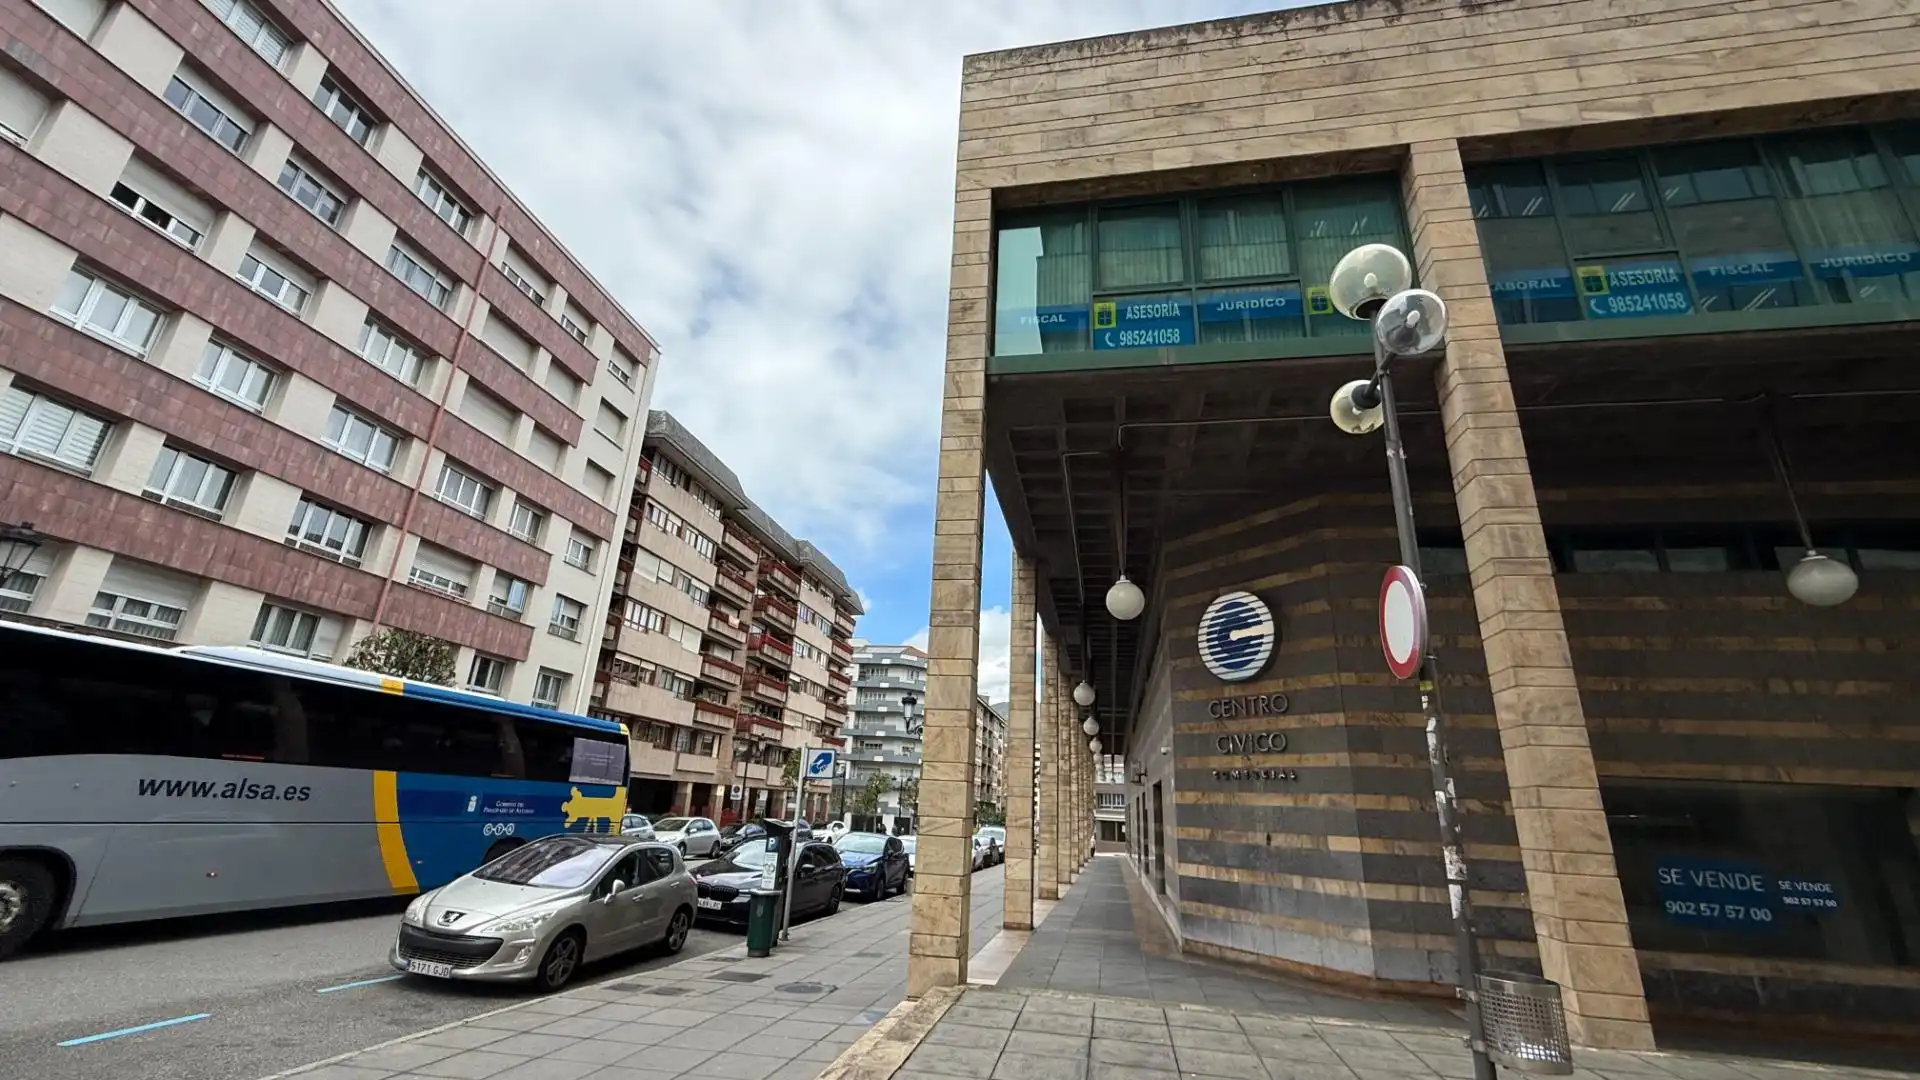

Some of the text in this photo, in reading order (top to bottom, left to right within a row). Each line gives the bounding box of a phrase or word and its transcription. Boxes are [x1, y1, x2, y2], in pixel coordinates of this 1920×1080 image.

[1608, 265, 1680, 287] ASESORÍA
[1708, 263, 1775, 277] FISCAL
[1493, 278, 1561, 292] ABORAL
[1125, 300, 1181, 320] ASESORÍA
[1607, 292, 1686, 313] 985241058
[1020, 314, 1067, 326] FISCAL
[1119, 328, 1181, 346] 985241058
[1208, 694, 1289, 718] CENTRO
[138, 777, 312, 802] www.alsa.es
[1658, 866, 1766, 892] SE VENDE
[1778, 880, 1834, 894] SE VENDE
[1665, 900, 1773, 922] 902 57 57 00
[411, 961, 431, 974] 5171
